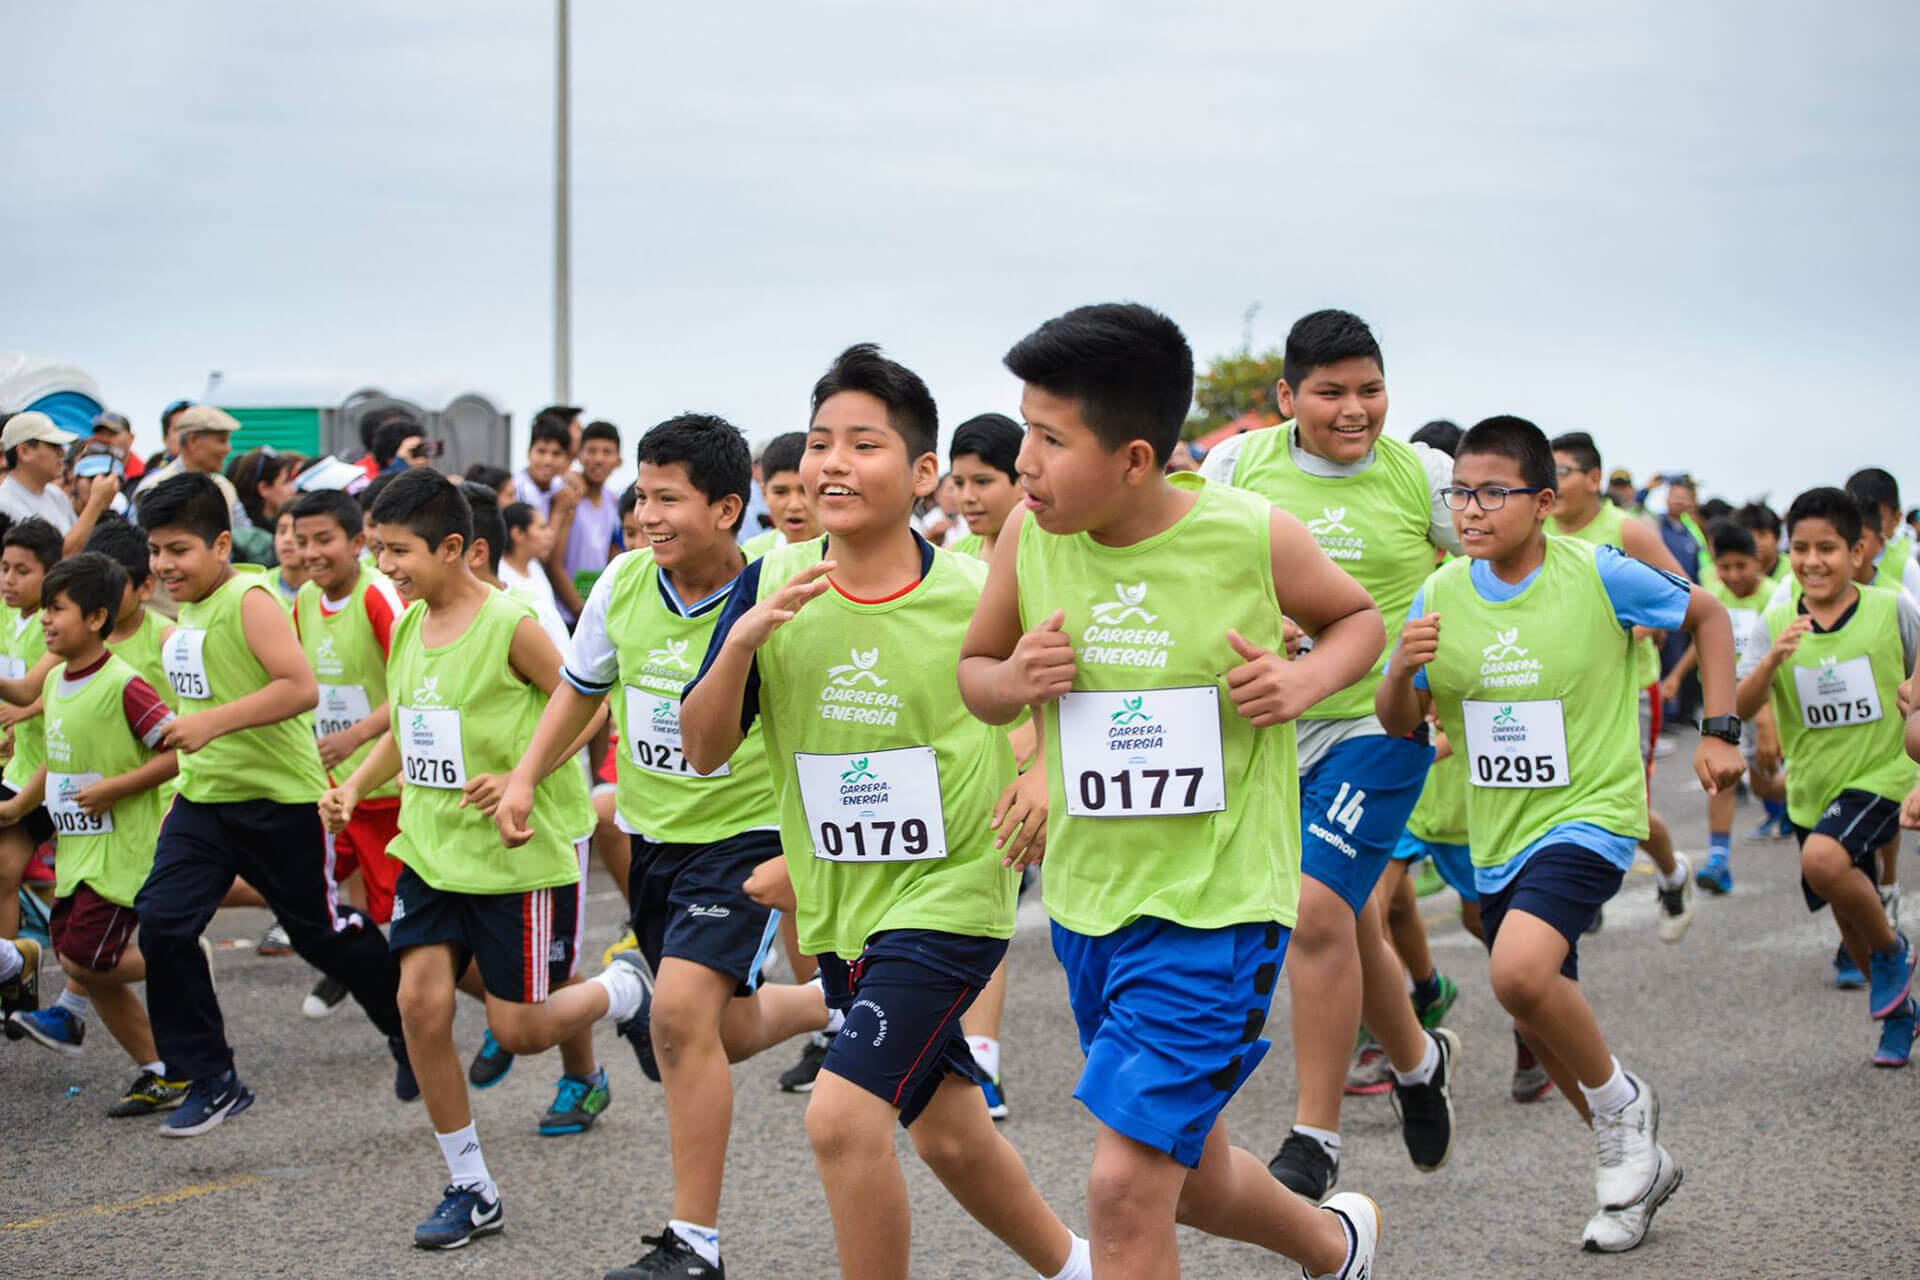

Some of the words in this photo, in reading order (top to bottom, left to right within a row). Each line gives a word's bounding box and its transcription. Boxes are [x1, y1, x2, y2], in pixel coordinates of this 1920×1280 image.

[1082, 624, 1170, 646] CARRERA
[1082, 645, 1168, 668] ENERGÍA
[1481, 658, 1540, 675] CARRERA
[169, 671, 203, 695] 0275
[1482, 672, 1540, 688] ENERGÍA
[821, 685, 899, 708] CARRERA
[822, 703, 898, 726] ENERGÍA
[1807, 698, 1871, 725] 0075
[1109, 725, 1162, 738] CARRERA
[1110, 736, 1163, 751] ENERGÍA
[638, 740, 687, 772] 027
[407, 756, 456, 783] 0276
[1477, 754, 1555, 783] 0295
[840, 782, 888, 795] CARRERA
[842, 792, 889, 806] ENERGÍA
[1080, 767, 1204, 811] 0177
[1326, 782, 1366, 835] 14
[53, 812, 102, 832] 0039
[821, 818, 929, 856] 0179
[1308, 823, 1357, 859] marathon
[873, 1020, 888, 1047] SAVIO
